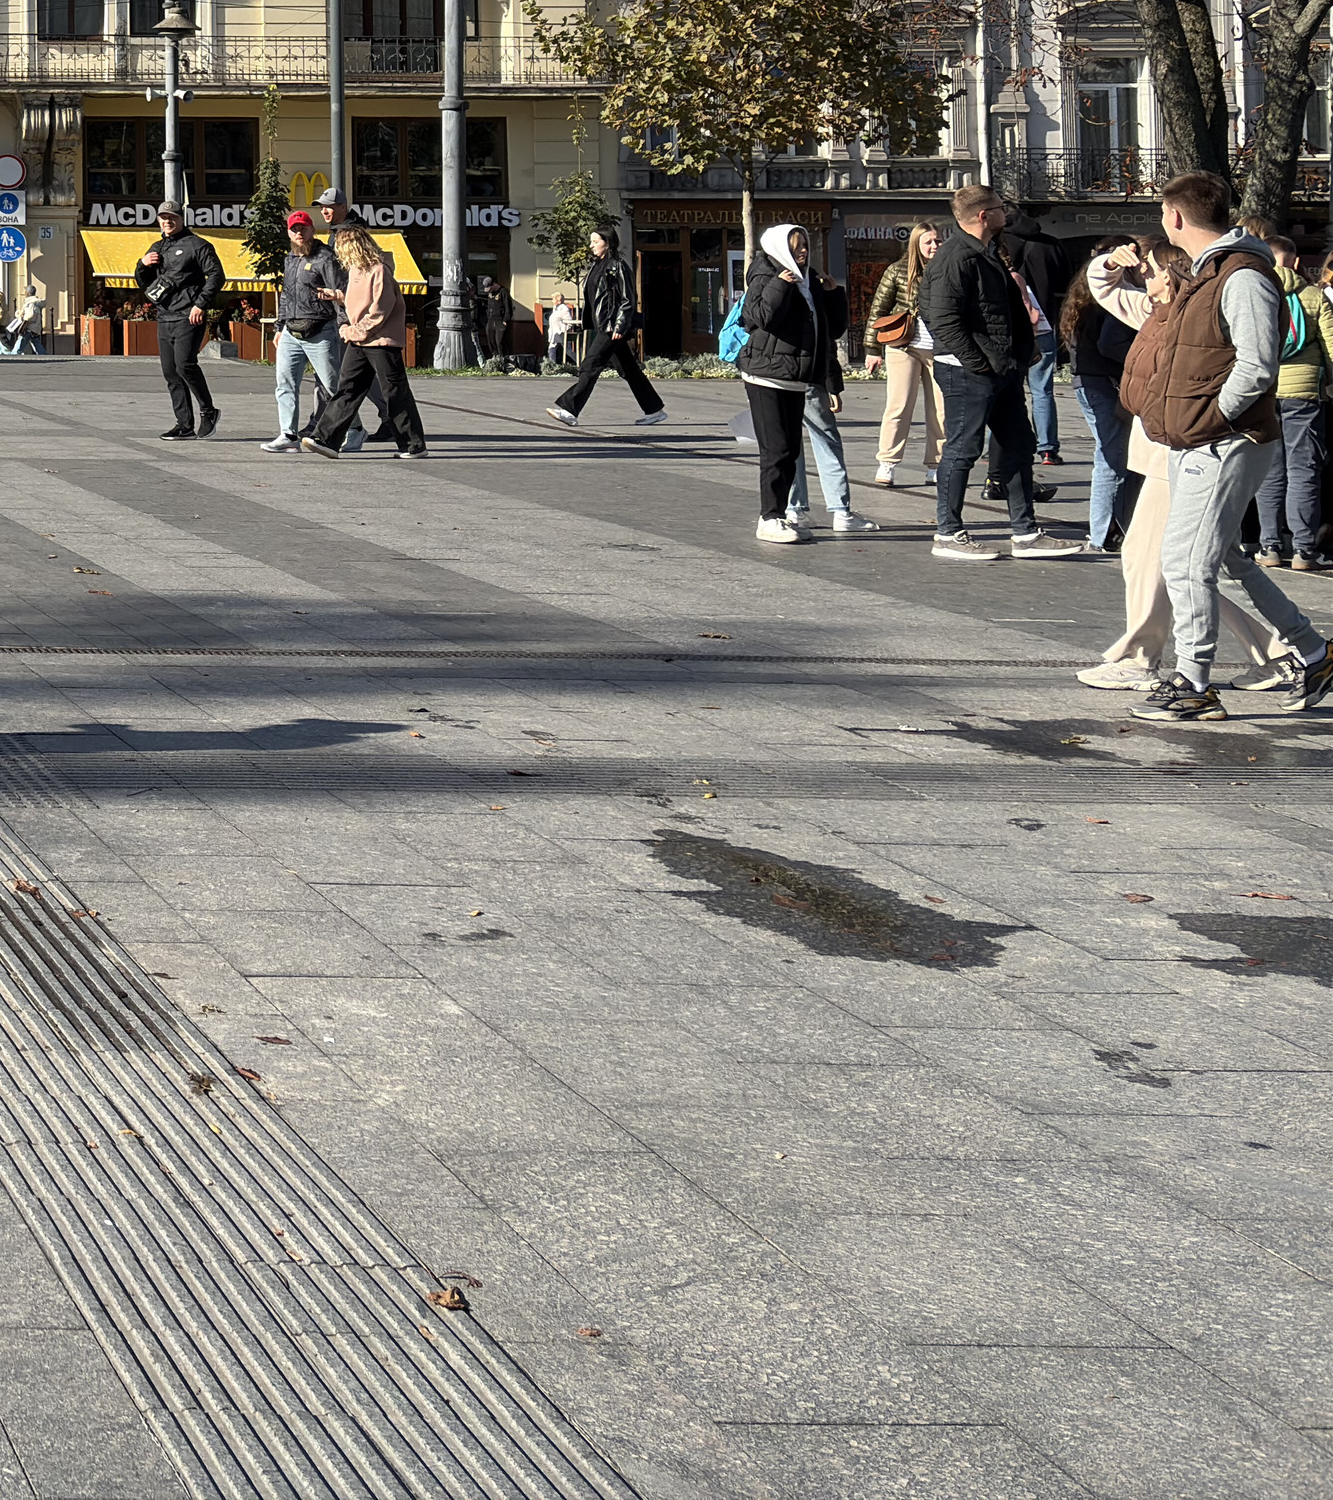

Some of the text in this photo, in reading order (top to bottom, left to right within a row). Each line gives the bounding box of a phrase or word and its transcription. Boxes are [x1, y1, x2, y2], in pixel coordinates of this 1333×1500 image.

[89, 203, 257, 227] McDnald's
[643, 209, 824, 224] ТЕАТРАЛЬІ КАСИ
[40, 227, 52, 239] 35
